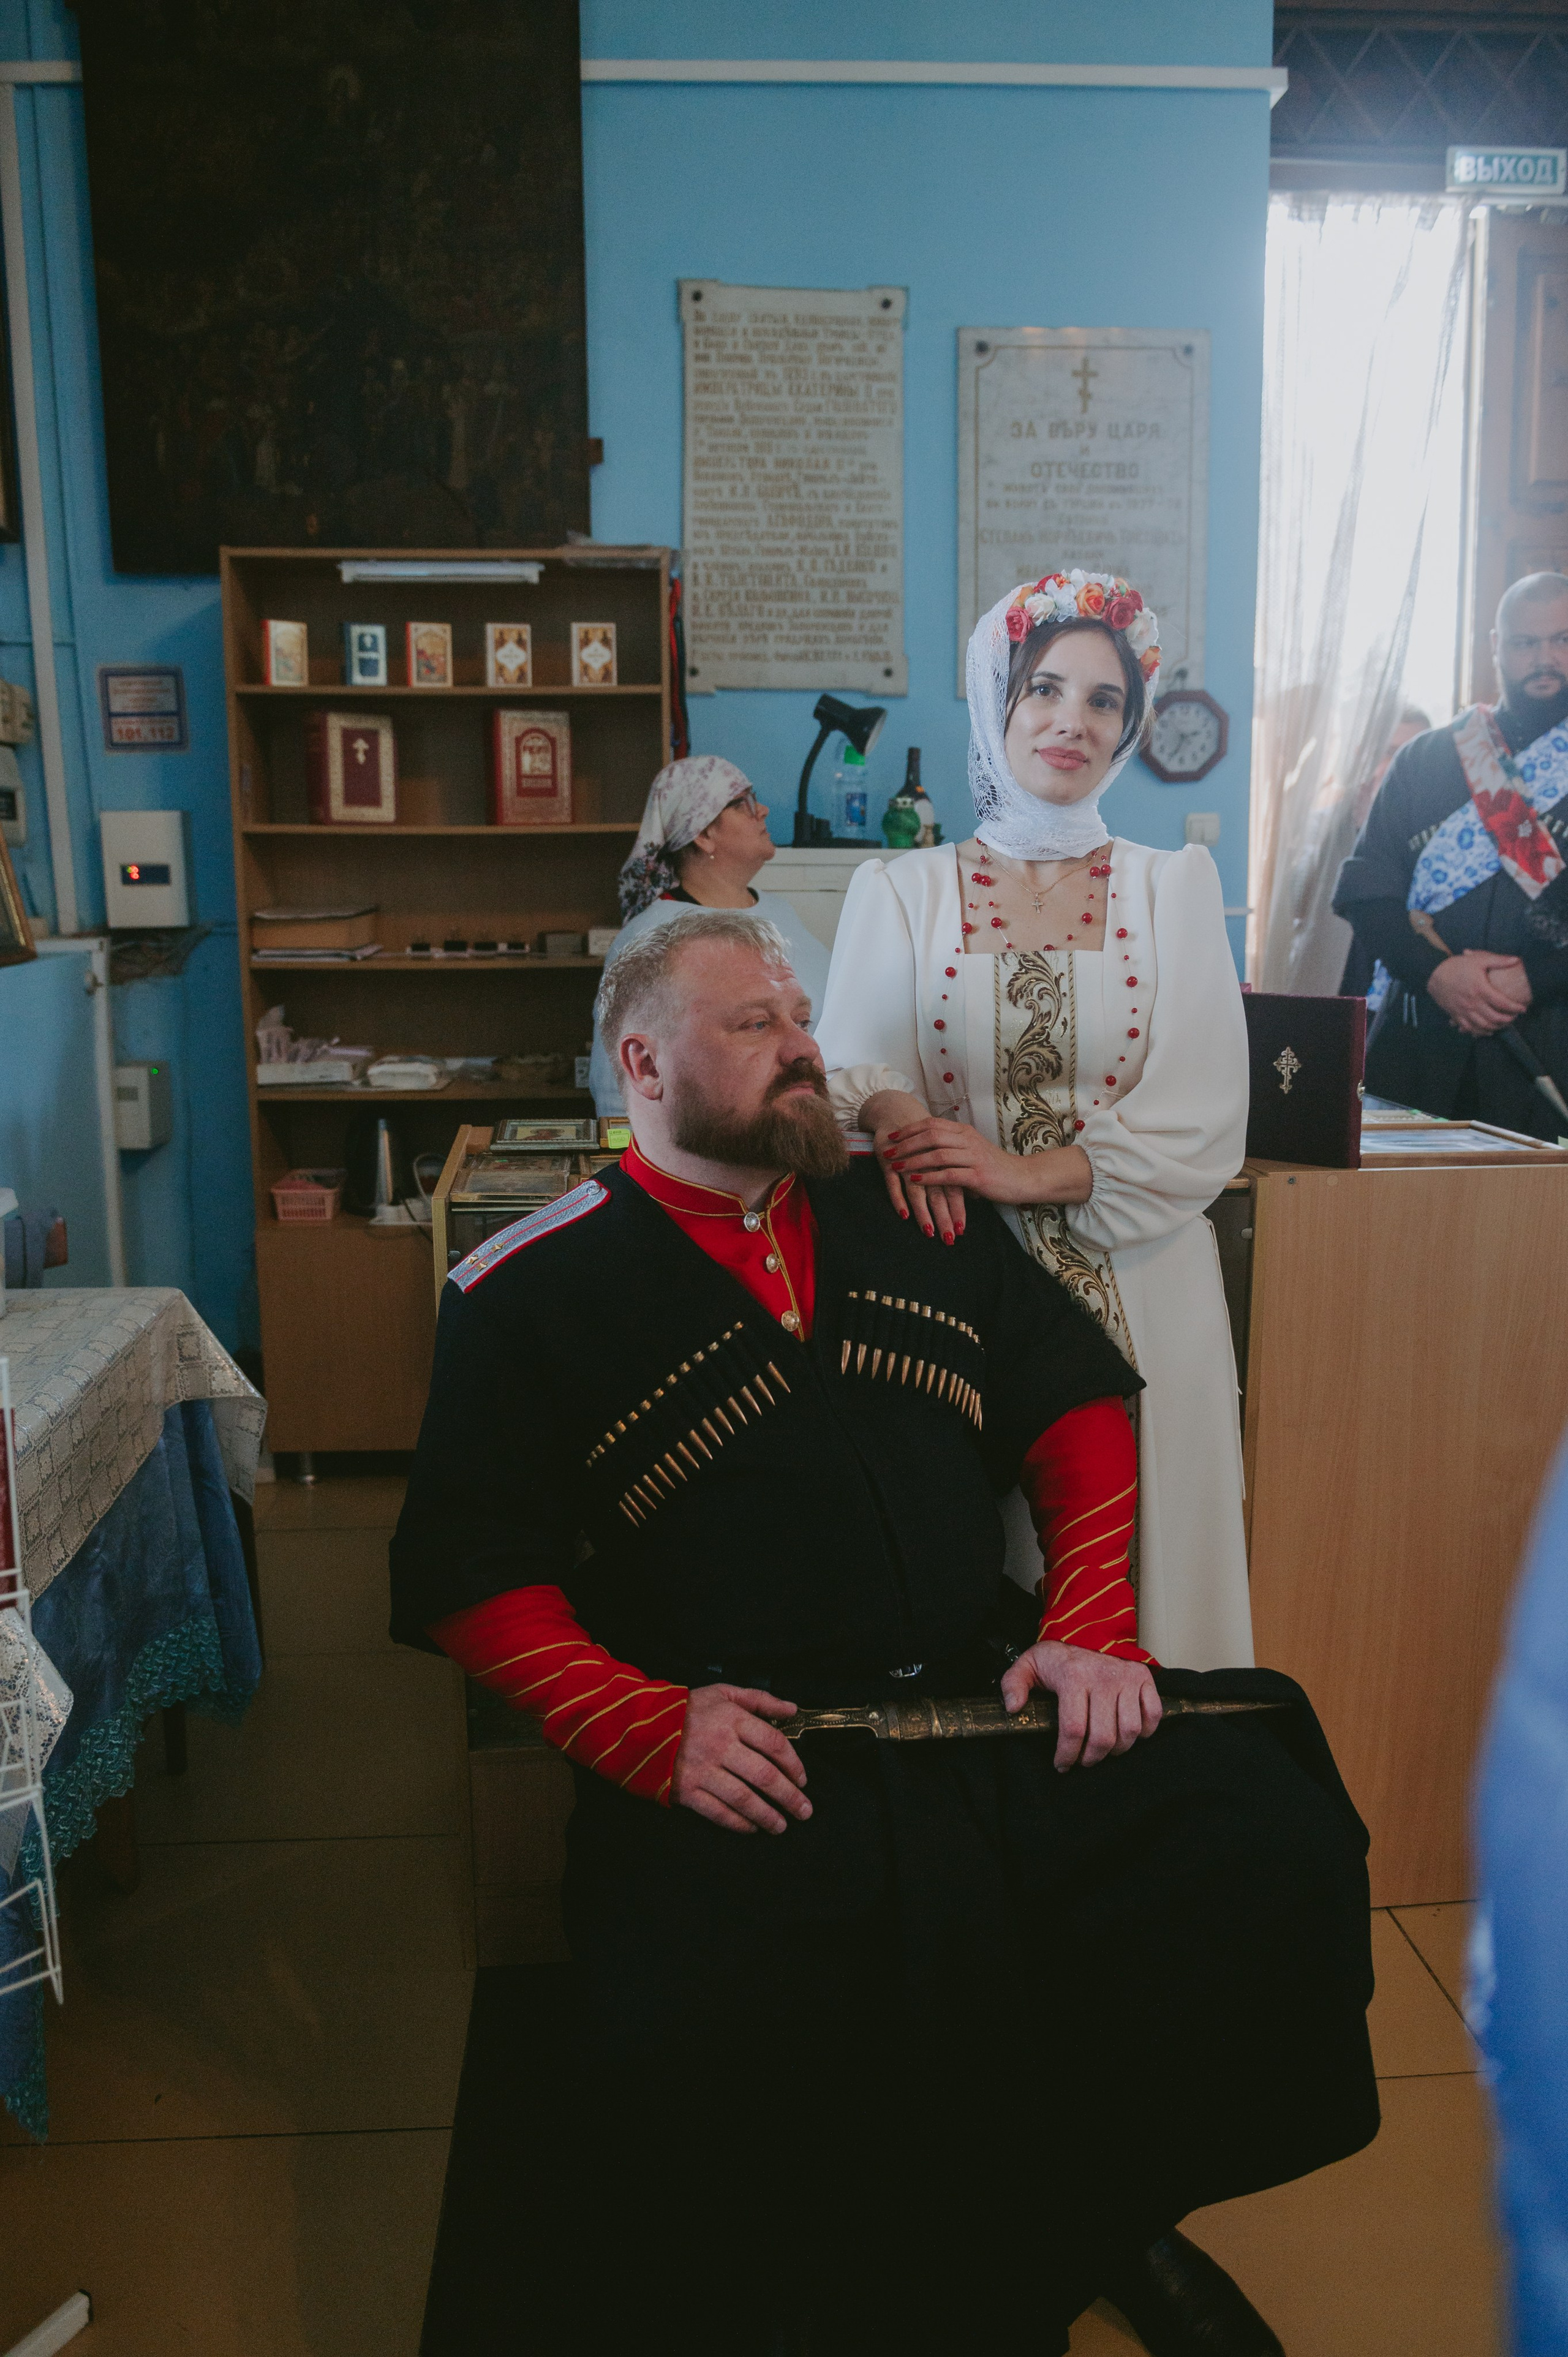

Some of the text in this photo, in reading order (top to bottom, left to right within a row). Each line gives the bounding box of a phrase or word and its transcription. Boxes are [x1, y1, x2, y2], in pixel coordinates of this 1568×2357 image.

[1459, 156, 1553, 184] ВЫХОД
[1010, 421, 1038, 439] ЗА
[1108, 422, 1161, 440] ЦАРЯ
[1030, 461, 1140, 479] ОТЕЧЕСТВО
